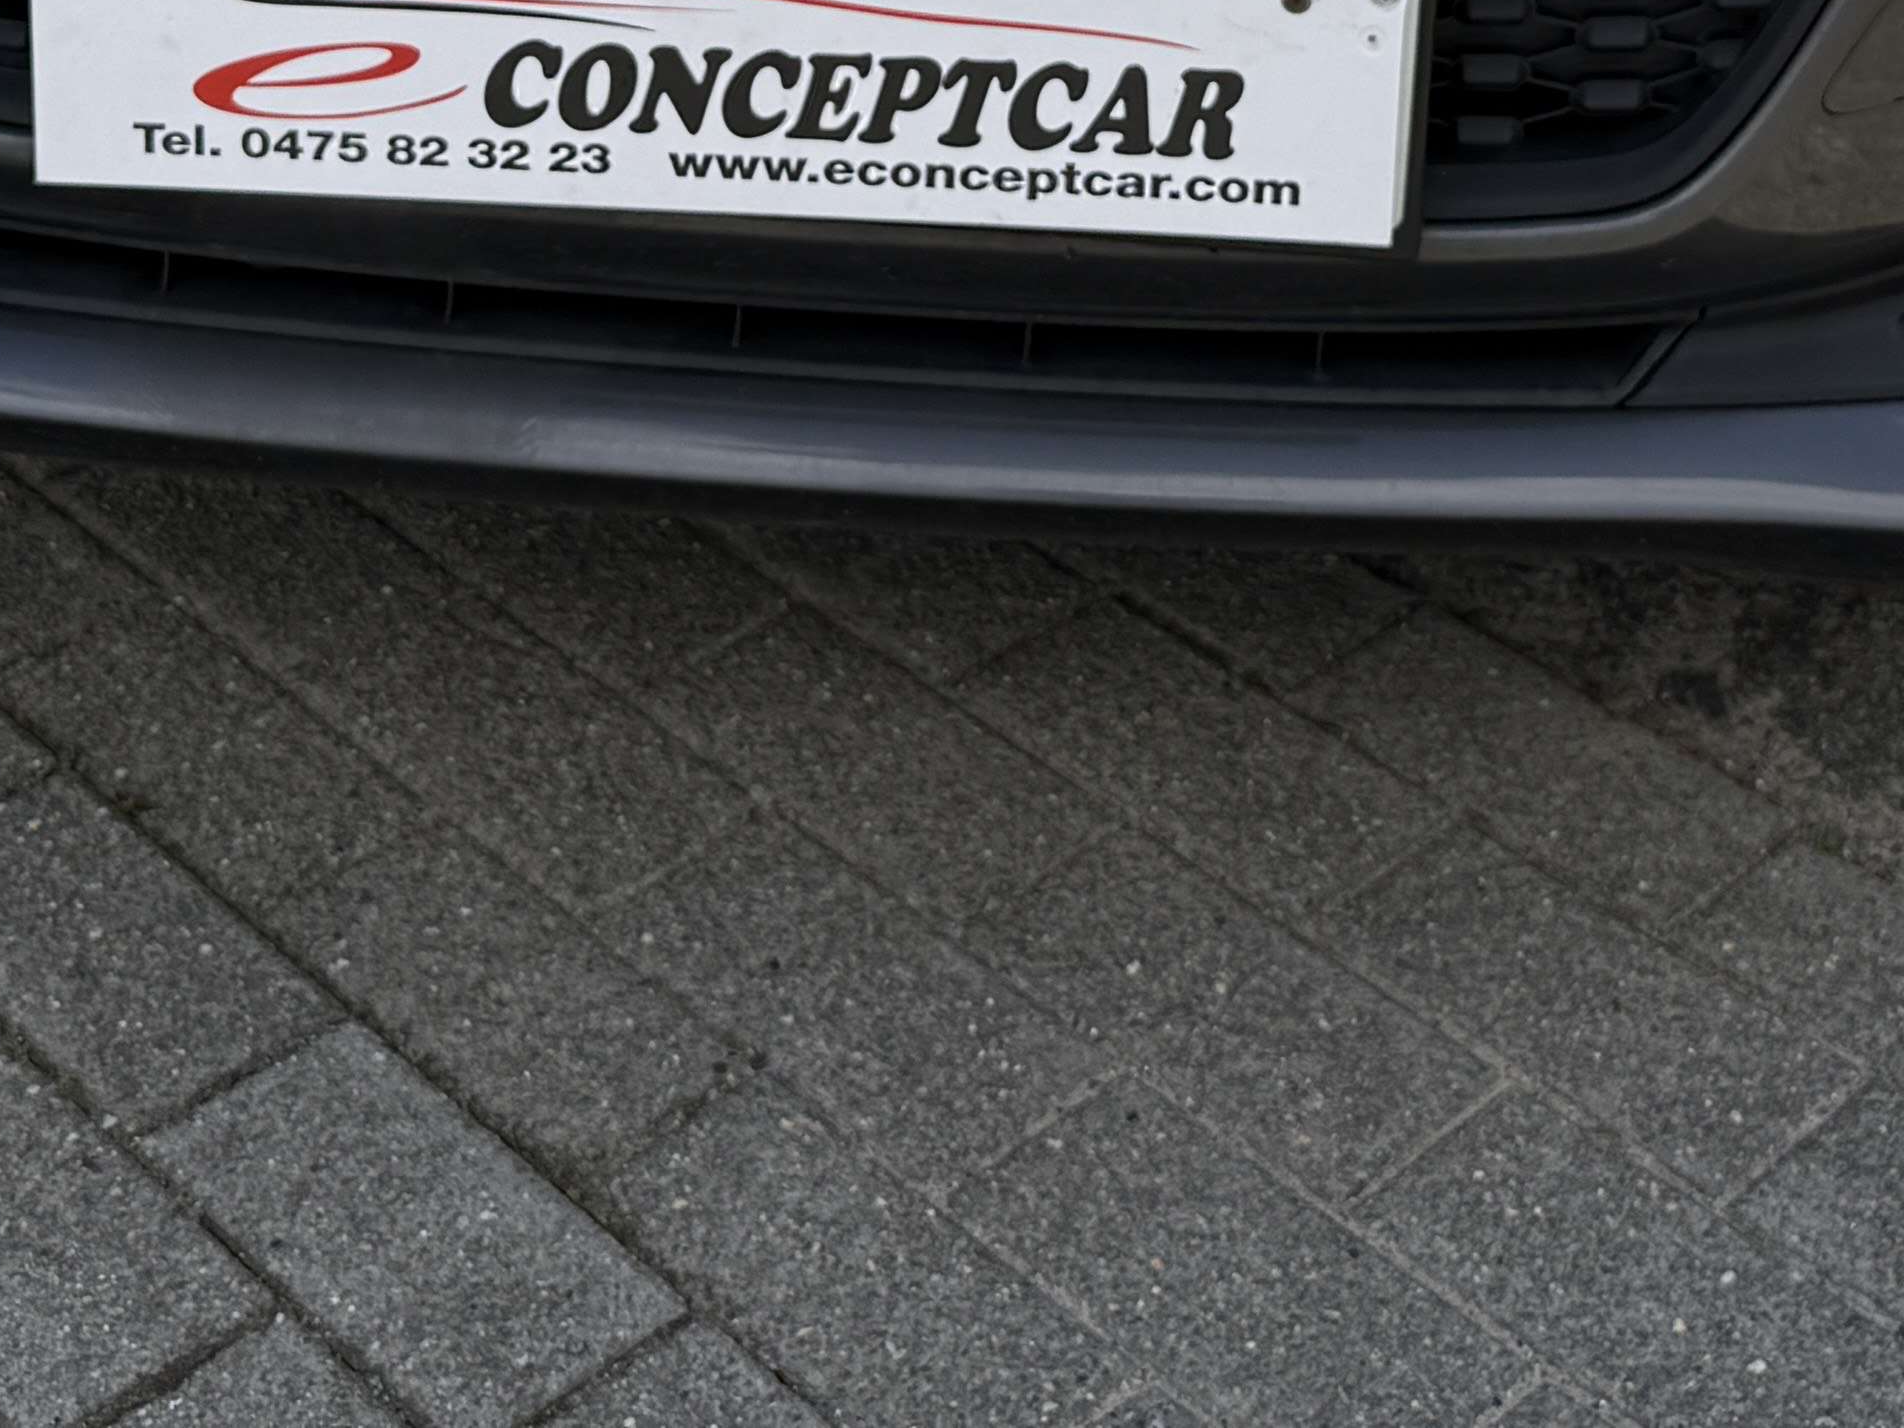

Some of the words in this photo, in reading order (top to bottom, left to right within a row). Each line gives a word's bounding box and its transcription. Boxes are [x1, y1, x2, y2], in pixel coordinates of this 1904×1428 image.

[483, 39, 1245, 159] CONCEPTCAR
[132, 122, 221, 157] Tel.
[242, 127, 368, 164] 0475
[386, 133, 450, 168] 82
[467, 139, 531, 172] 32
[548, 143, 612, 175] 23
[668, 151, 1300, 206] www.econceptcar.com
